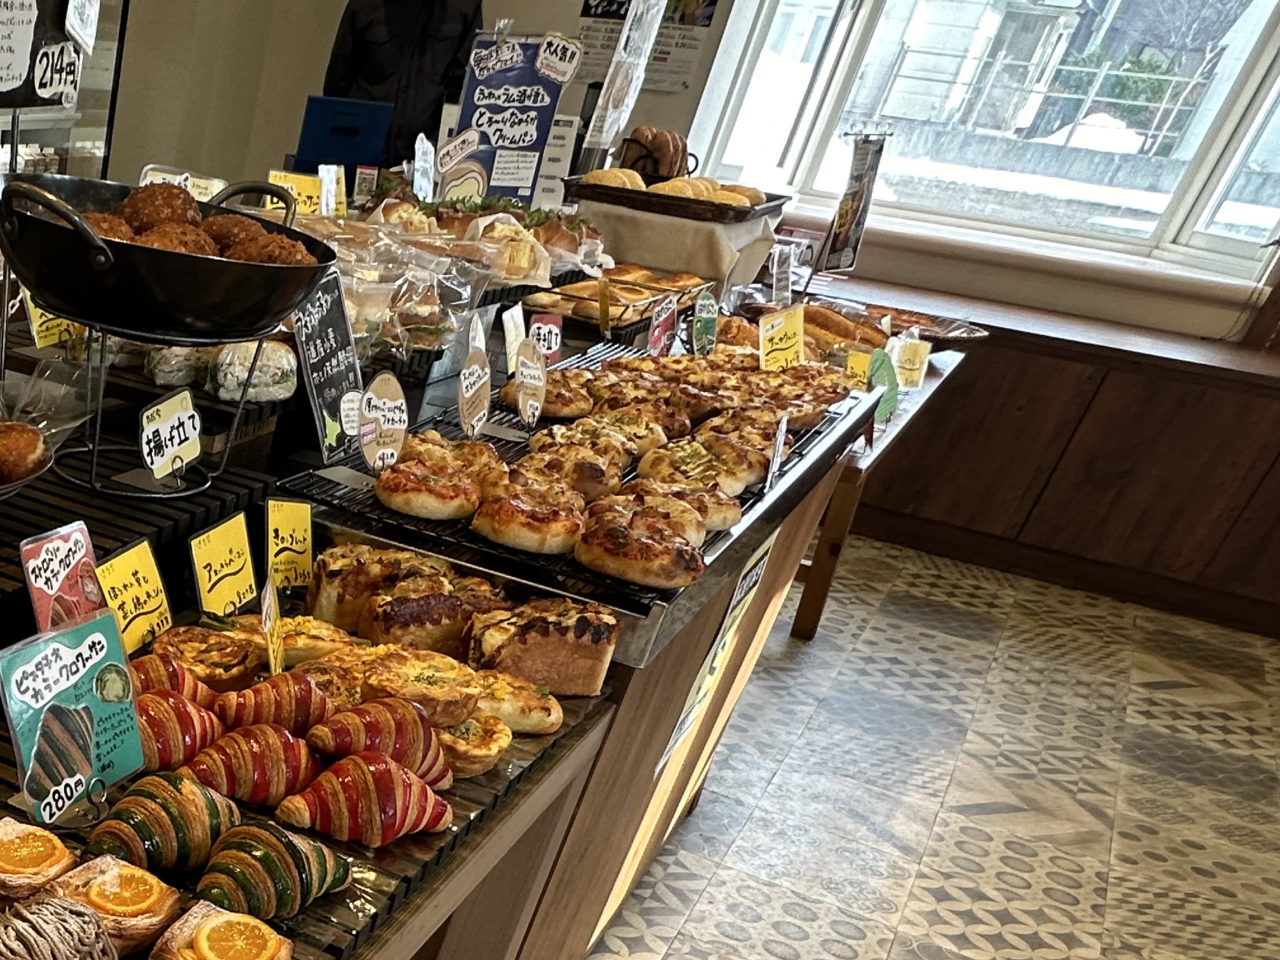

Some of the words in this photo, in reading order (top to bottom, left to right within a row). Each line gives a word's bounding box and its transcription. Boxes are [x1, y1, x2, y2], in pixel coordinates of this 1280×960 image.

[38, 46, 76, 90] 214円
[146, 414, 196, 466] 揚げ立て
[43, 778, 84, 821] 280円
